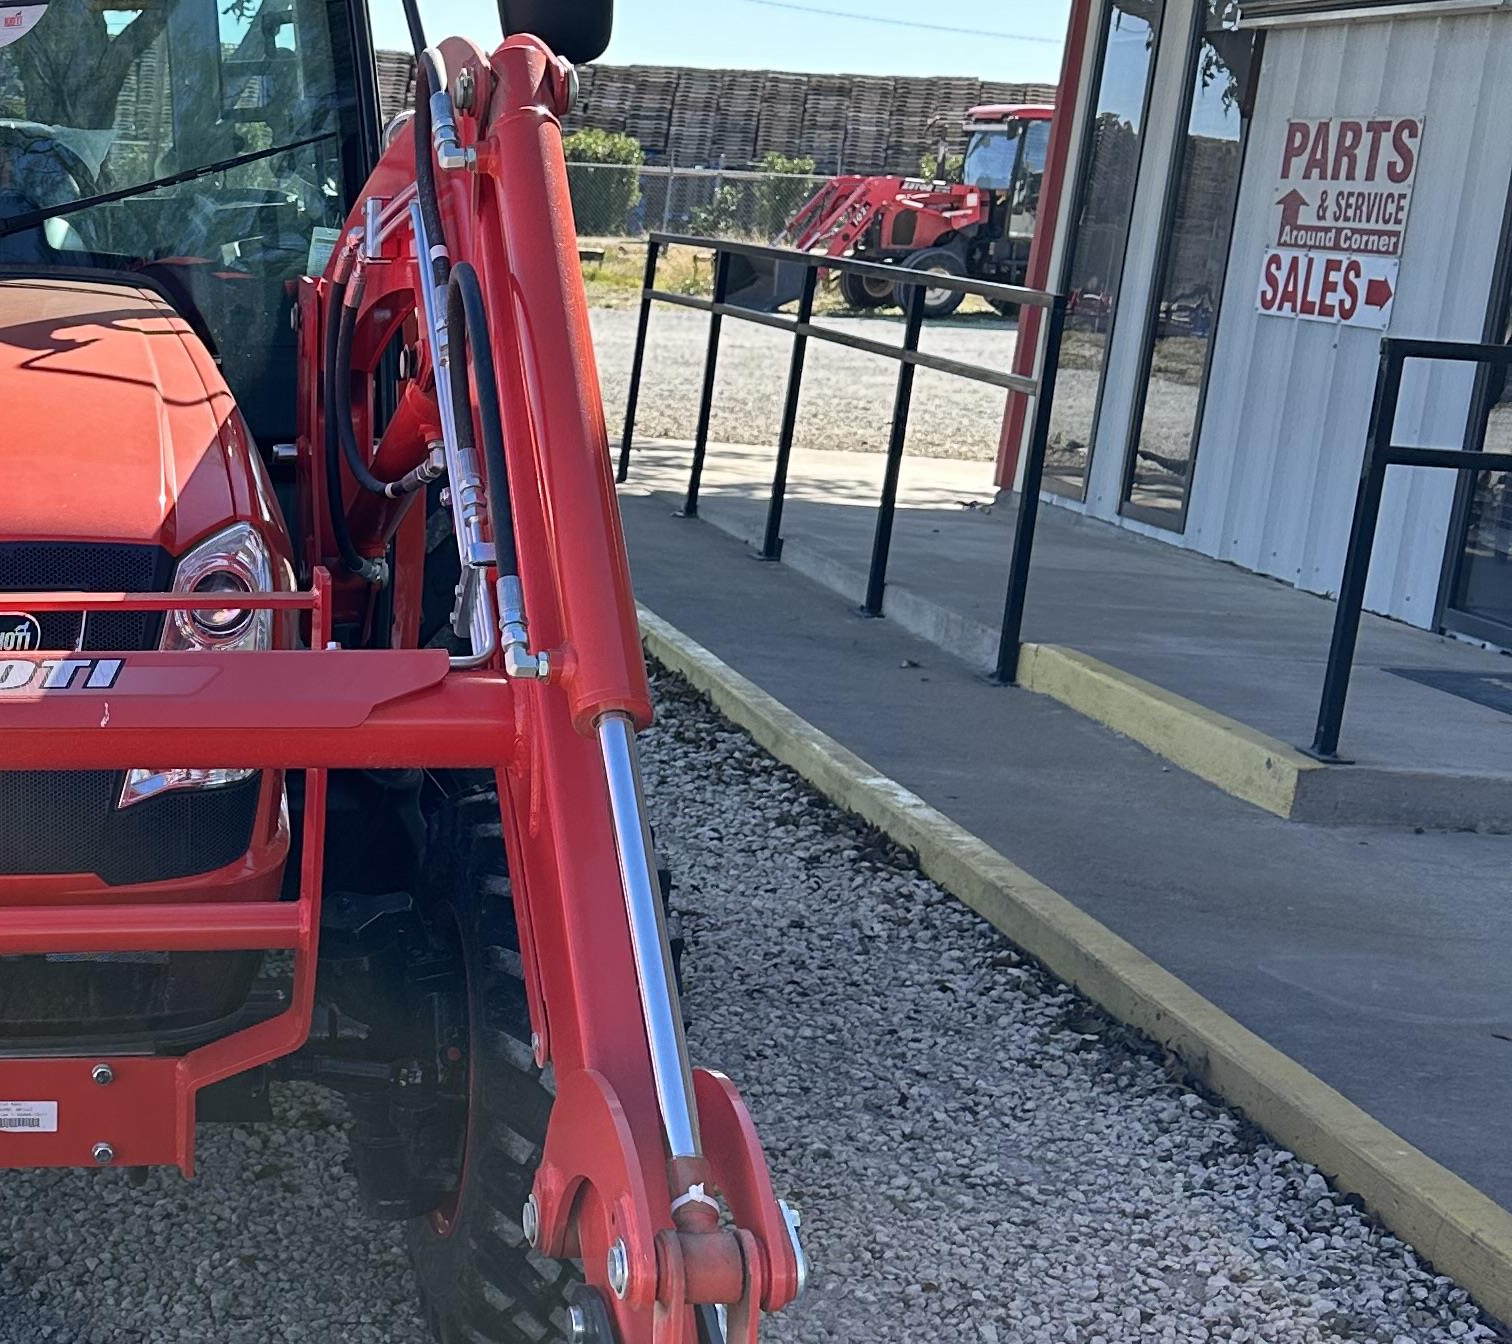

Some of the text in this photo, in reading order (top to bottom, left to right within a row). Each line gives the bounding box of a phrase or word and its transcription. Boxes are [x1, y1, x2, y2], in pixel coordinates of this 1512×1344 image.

[1280, 118, 1419, 184] PARTS
[1316, 190, 1407, 225] & SERVICE
[1280, 225, 1398, 252] Around Corner
[1260, 253, 1362, 321] SALES
